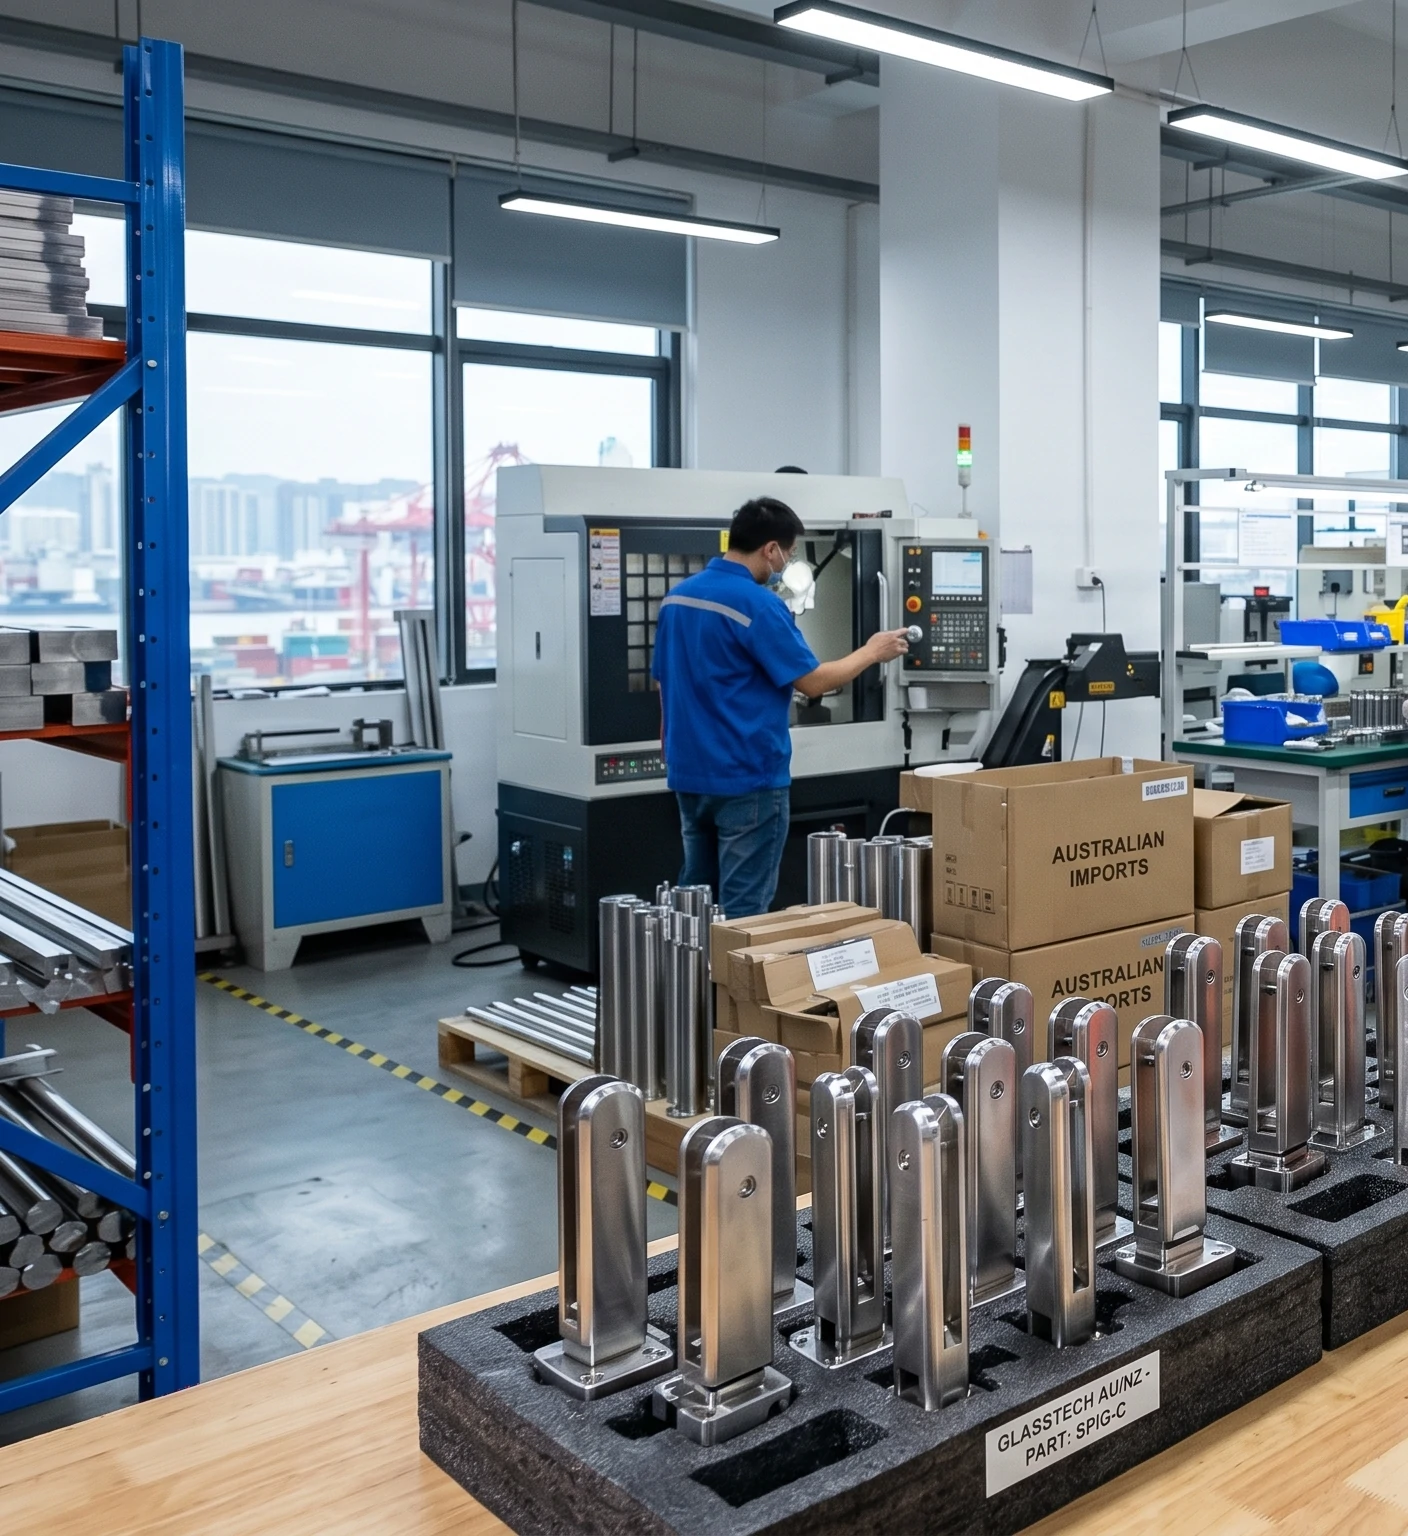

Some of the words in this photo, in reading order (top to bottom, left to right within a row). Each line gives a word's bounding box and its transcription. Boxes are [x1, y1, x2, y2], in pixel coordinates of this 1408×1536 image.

[1052, 830, 1165, 864] AUSTRALIAN
[1070, 858, 1149, 888] IMPORTS
[1051, 955, 1164, 999] AUSTRALIAN
[998, 1392, 1094, 1453] GLASSTECH
[1098, 1368, 1143, 1404] AU/NZ
[1026, 1430, 1071, 1466] PART:
[1076, 1401, 1127, 1440] SPIG-C
